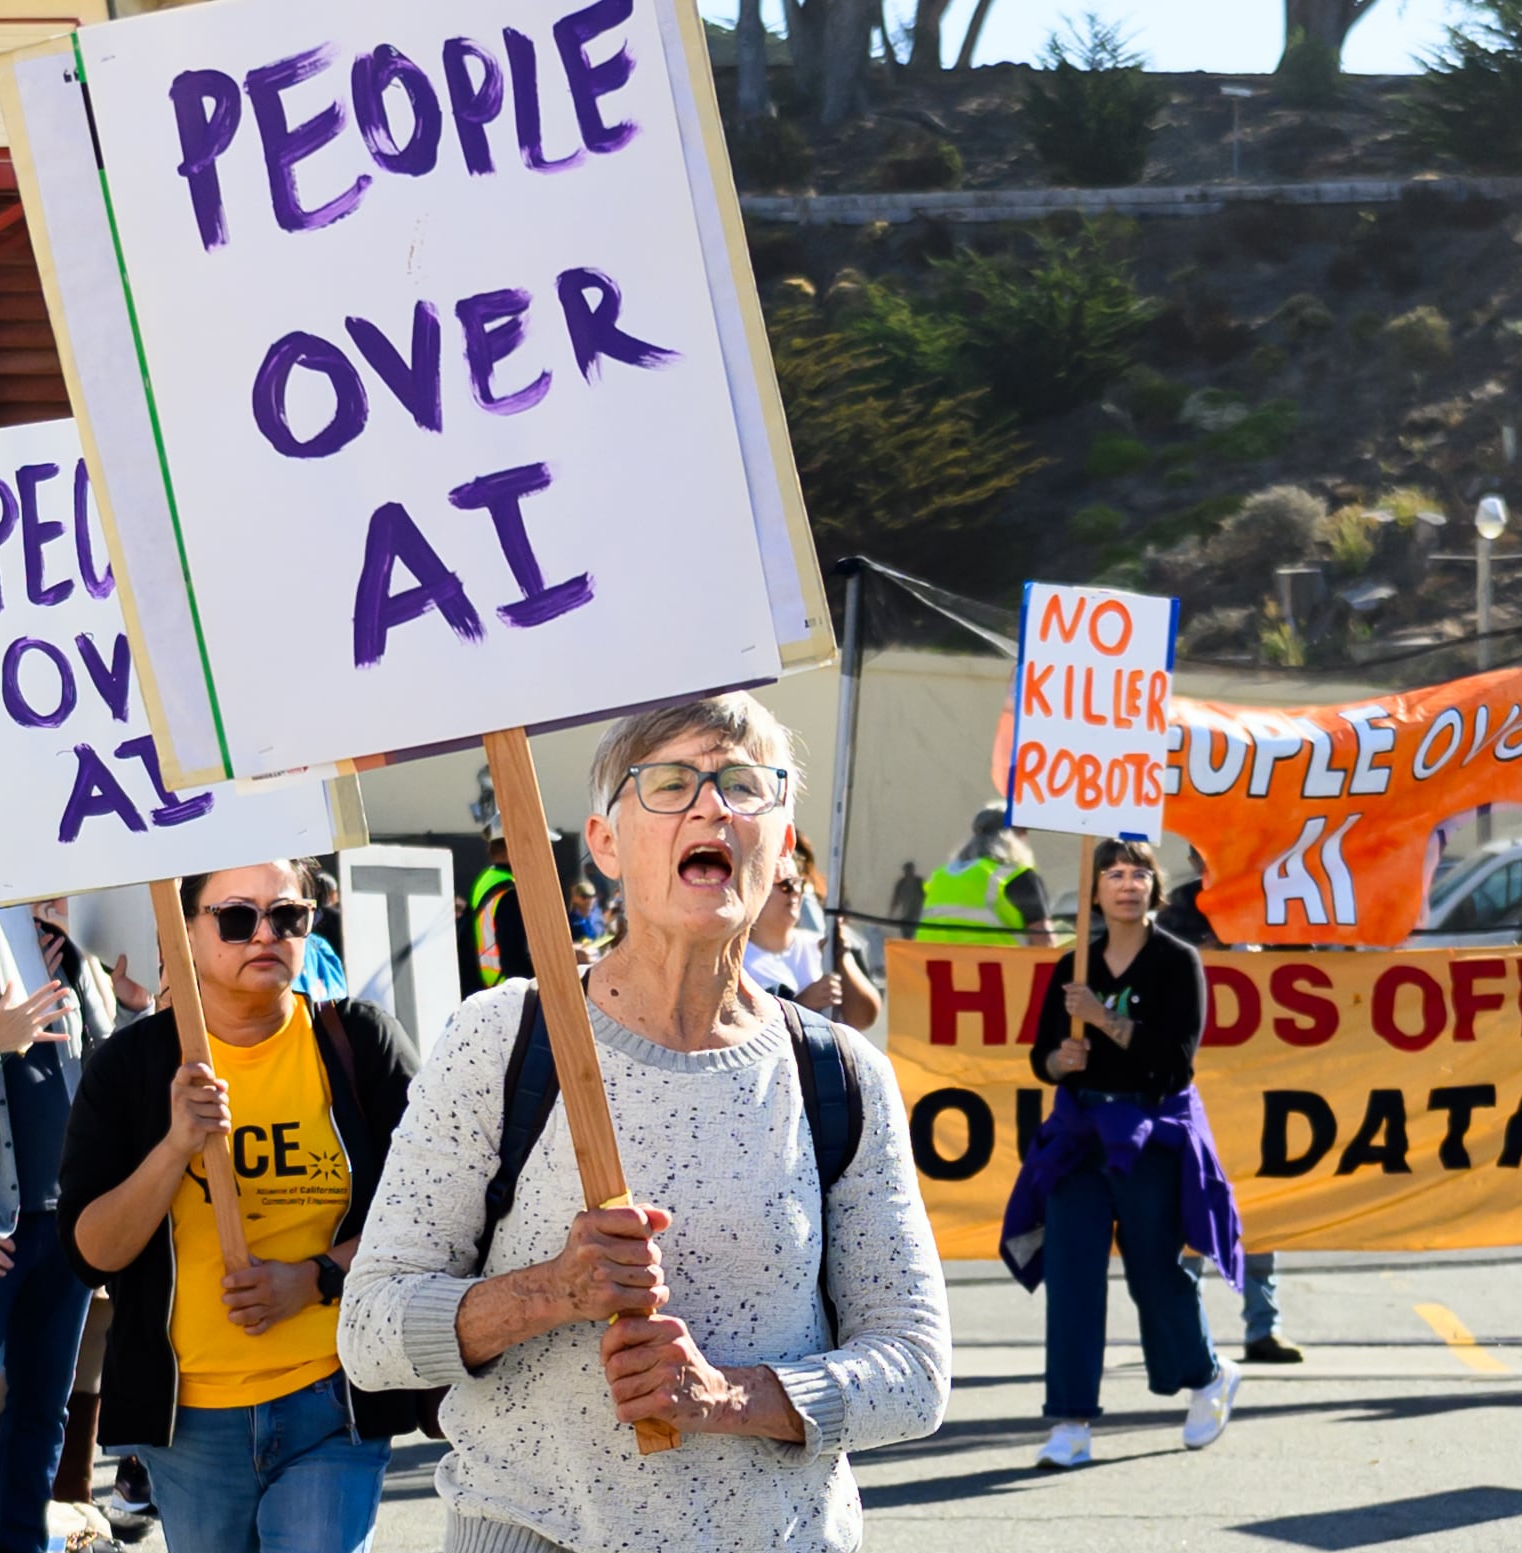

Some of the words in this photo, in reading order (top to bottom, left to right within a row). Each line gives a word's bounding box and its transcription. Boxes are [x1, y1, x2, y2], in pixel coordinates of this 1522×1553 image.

[168, 0, 642, 253] PEOPLE
[251, 267, 682, 459] OVER
[353, 462, 596, 669] AI
[1039, 594, 1133, 656] NO
[2, 632, 132, 729] OV
[1024, 661, 1167, 734] KILLER
[58, 735, 215, 843] AI
[1014, 741, 1165, 810] ROBOTS
[1166, 706, 1396, 798] OPLE
[1262, 813, 1362, 925] AI
[351, 865, 442, 1056] T
[926, 960, 1339, 1047] HDS
[234, 1122, 308, 1179] CE
